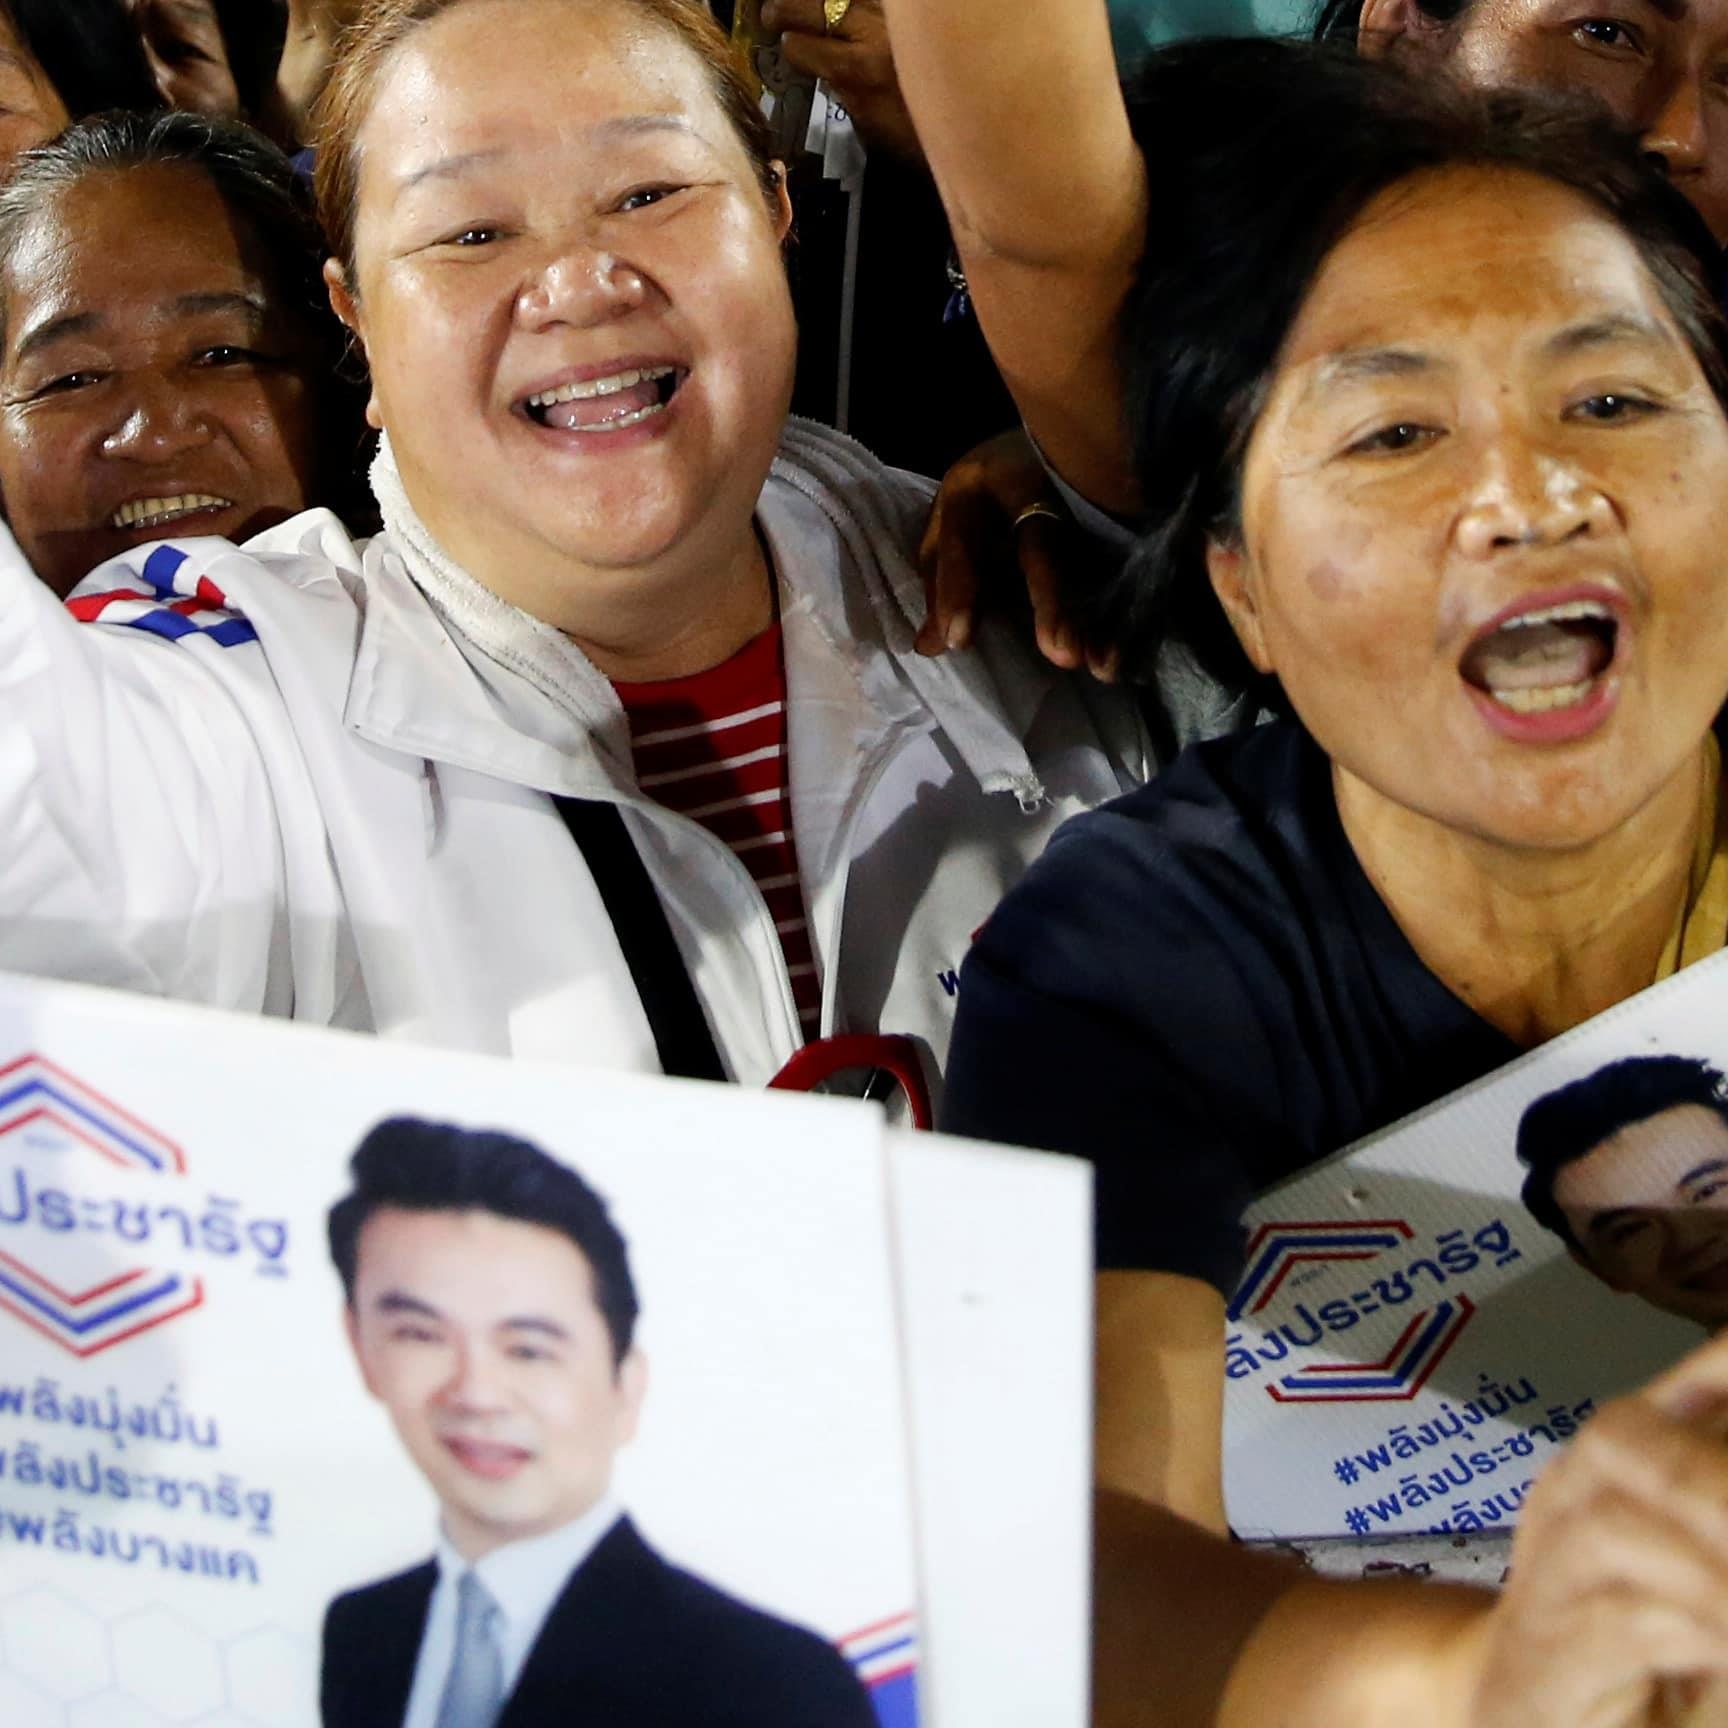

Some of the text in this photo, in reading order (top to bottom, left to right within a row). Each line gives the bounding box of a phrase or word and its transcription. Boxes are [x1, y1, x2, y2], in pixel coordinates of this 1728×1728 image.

[1226, 1218, 1522, 1380] ลังประชารัฐ
[1333, 1374, 1538, 1486] #พลังมุ่งมั่น
